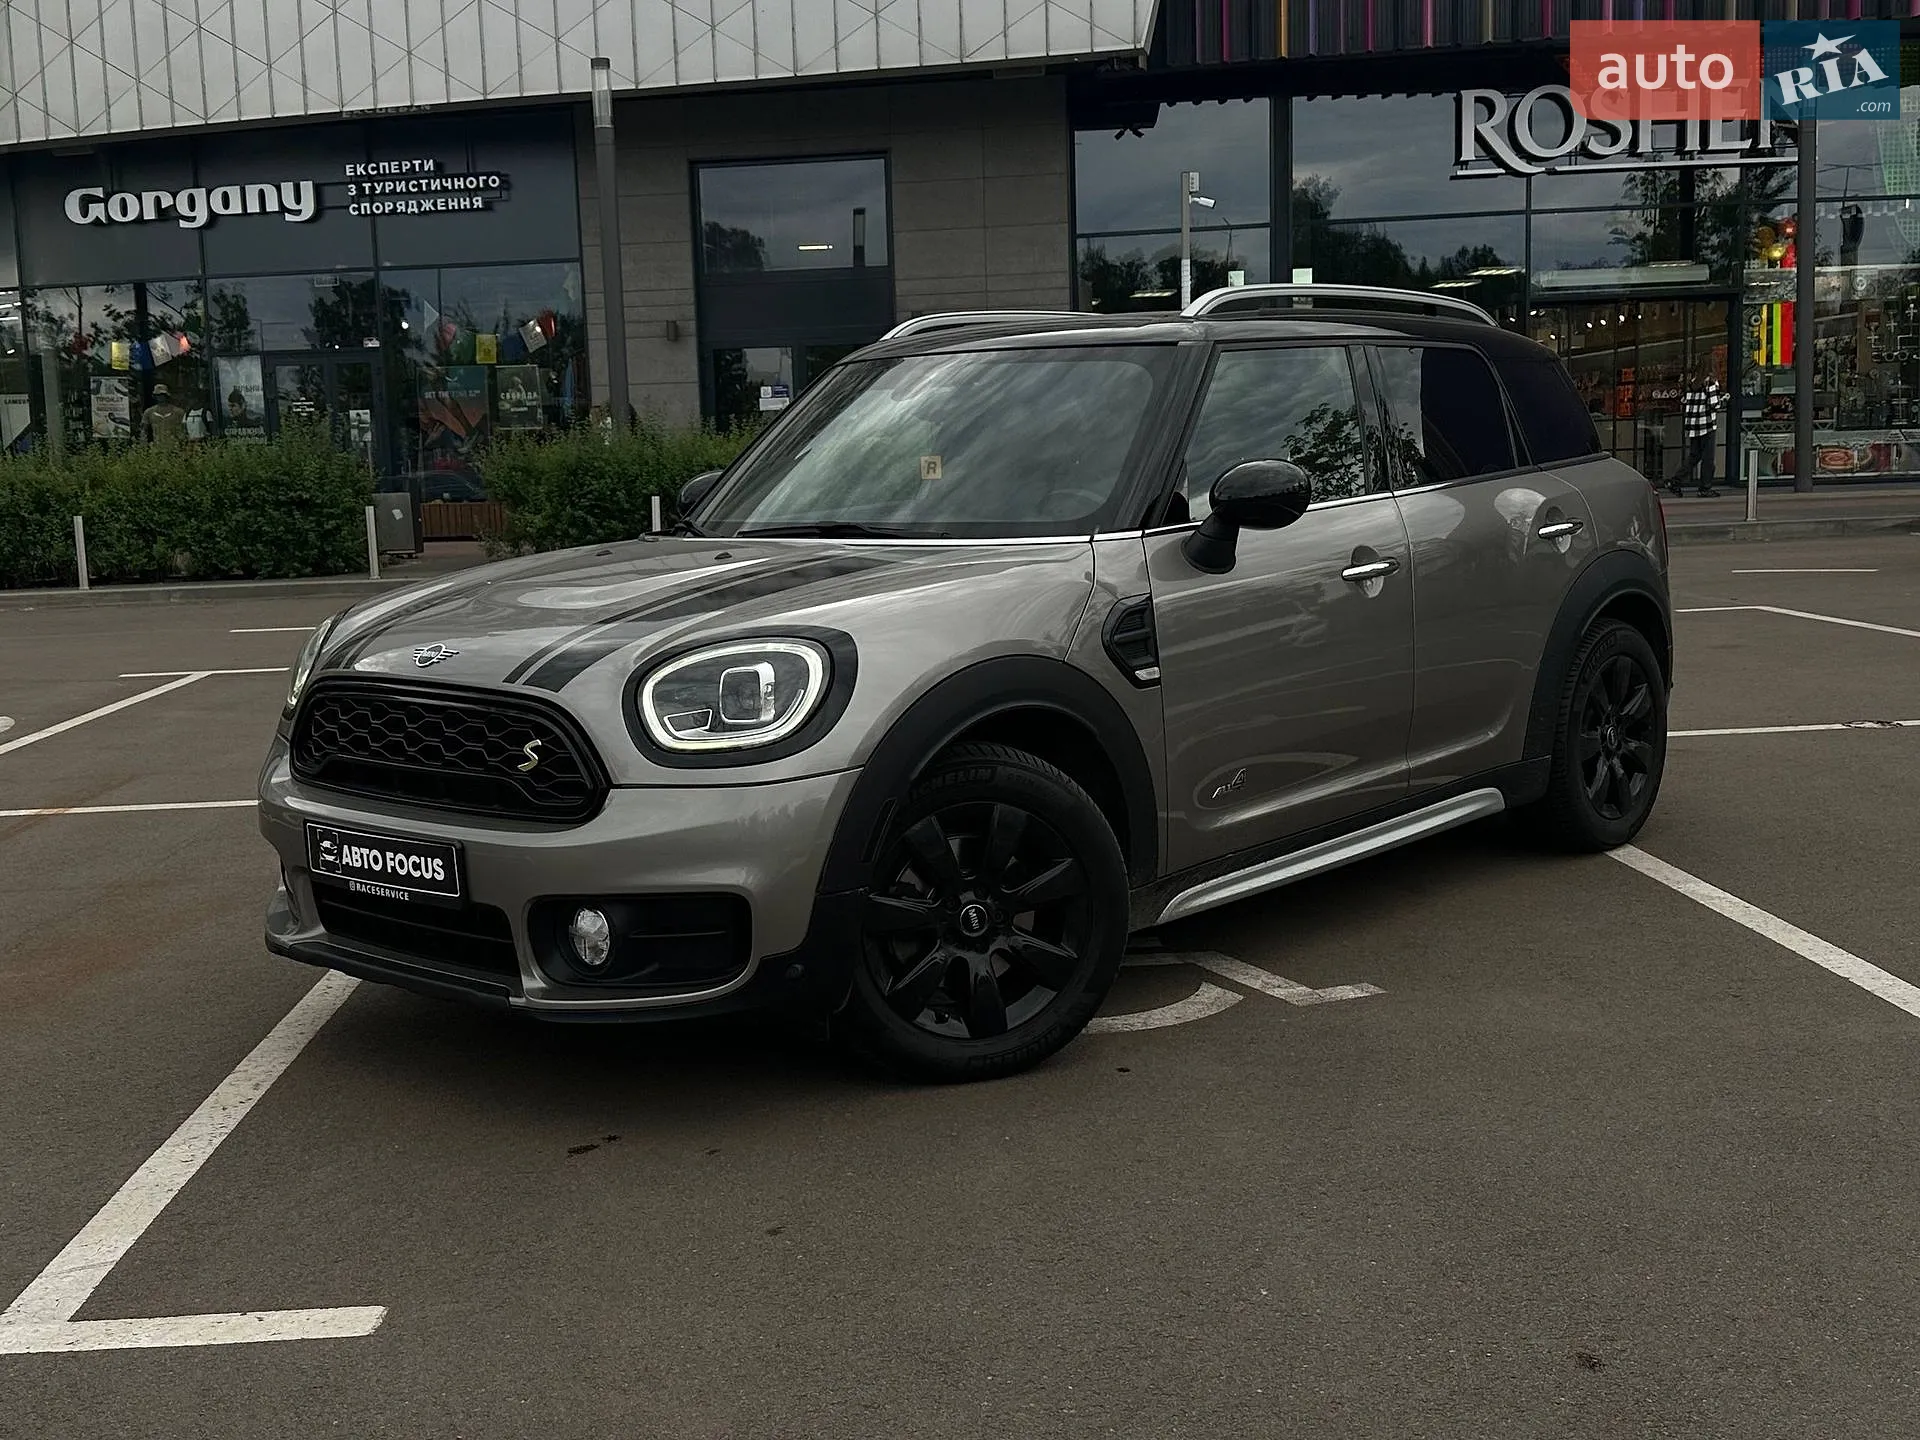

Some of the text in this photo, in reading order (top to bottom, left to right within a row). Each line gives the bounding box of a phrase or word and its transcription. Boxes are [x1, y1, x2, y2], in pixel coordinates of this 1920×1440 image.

[345, 158, 435, 176] ЕКСПЕРТИ
[362, 175, 501, 195] ТУРИСТИЧНОГО
[63, 180, 316, 229] Gorgany
[348, 196, 483, 216] СПОРЯДЖЕННЯ
[517, 739, 542, 772] S
[385, 851, 445, 881] FOCUS
[968, 907, 981, 930] MINI
